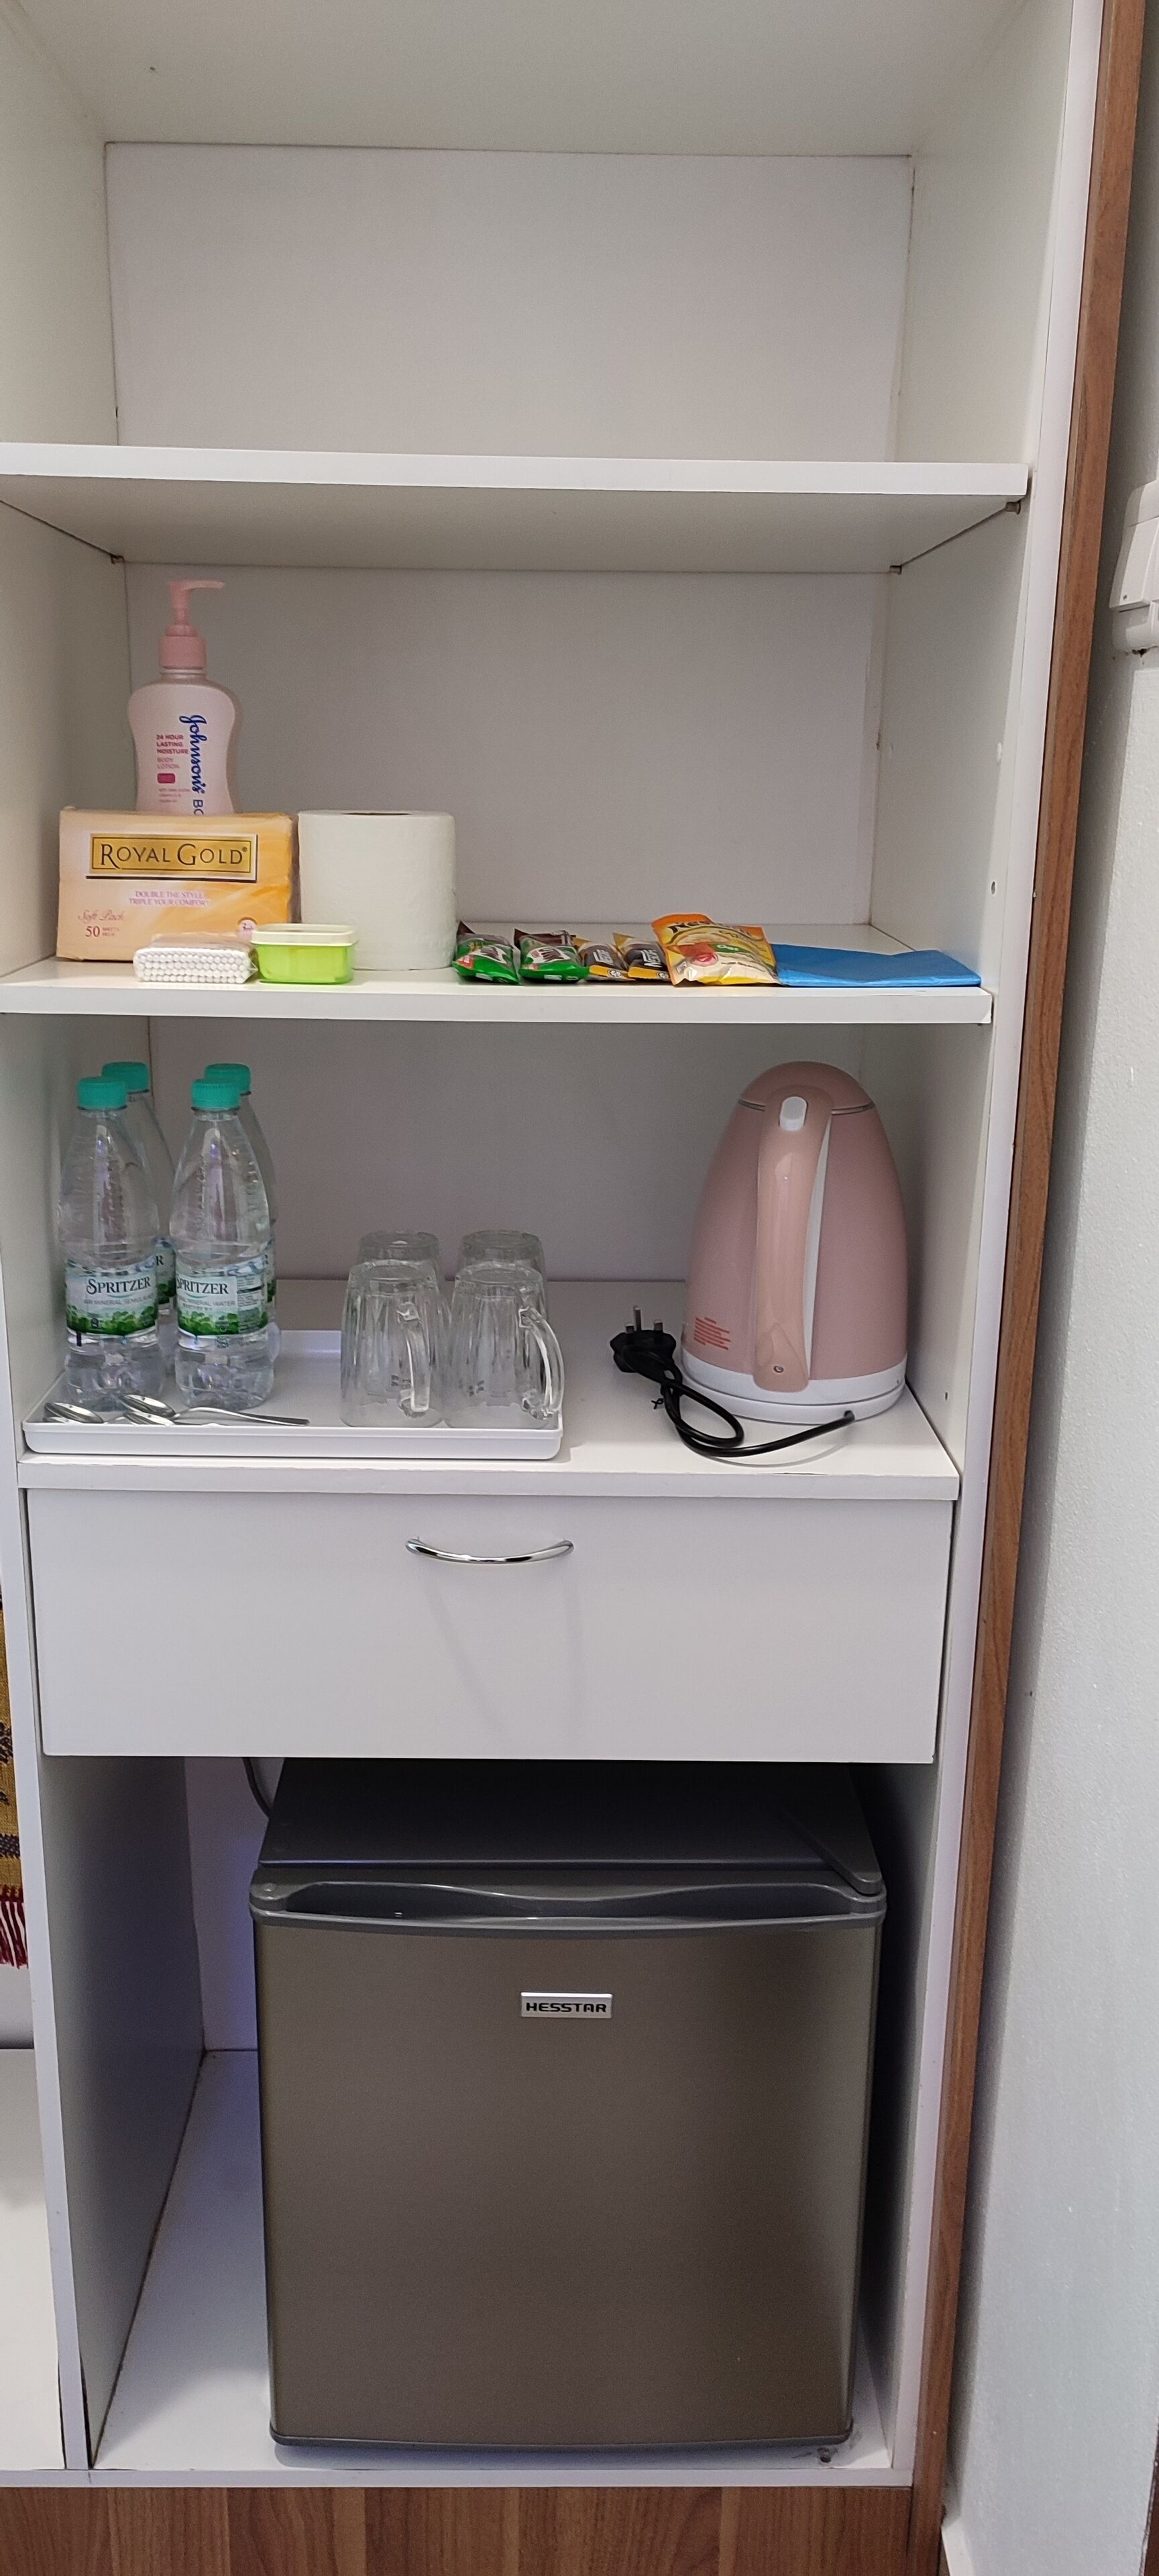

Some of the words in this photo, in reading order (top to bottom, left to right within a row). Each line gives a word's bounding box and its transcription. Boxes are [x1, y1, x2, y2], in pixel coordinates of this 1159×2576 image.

[179, 715, 207, 794] Johnson's
[101, 843, 170, 869] ROYAL
[182, 891, 205, 899] STYLE
[85, 926, 100, 937] 50
[86, 1277, 152, 1295] SPRITZER
[526, 2002, 607, 2012] HESSTAR
